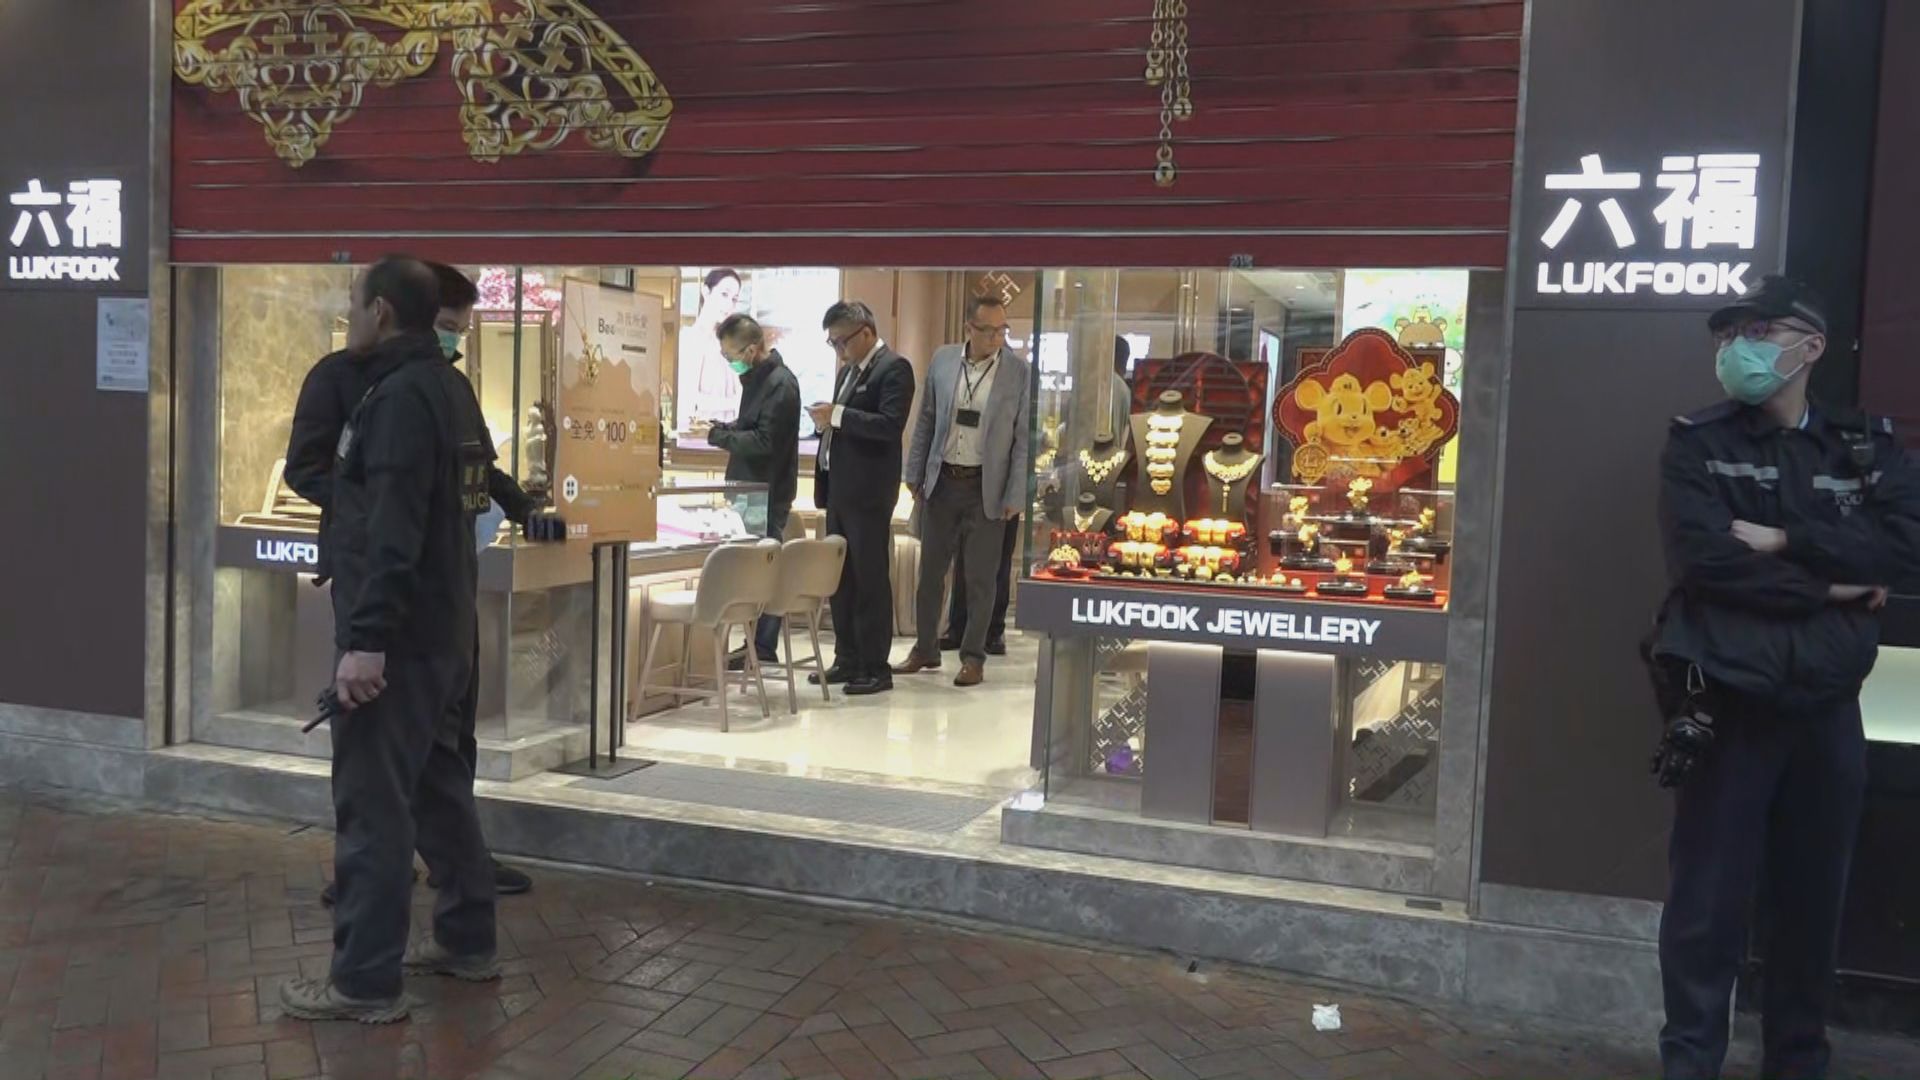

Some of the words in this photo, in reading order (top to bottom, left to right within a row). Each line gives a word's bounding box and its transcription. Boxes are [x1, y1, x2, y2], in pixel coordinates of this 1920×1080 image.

[9, 178, 122, 248] 六福
[1540, 153, 1761, 250] 六福
[9, 255, 121, 281] LUKFOOK
[1536, 261, 1751, 296] LUKFOOK
[256, 539, 319, 565] LUKFO
[1071, 597, 1200, 632] LUKFOOK
[1206, 608, 1381, 646] JEWELLERY
